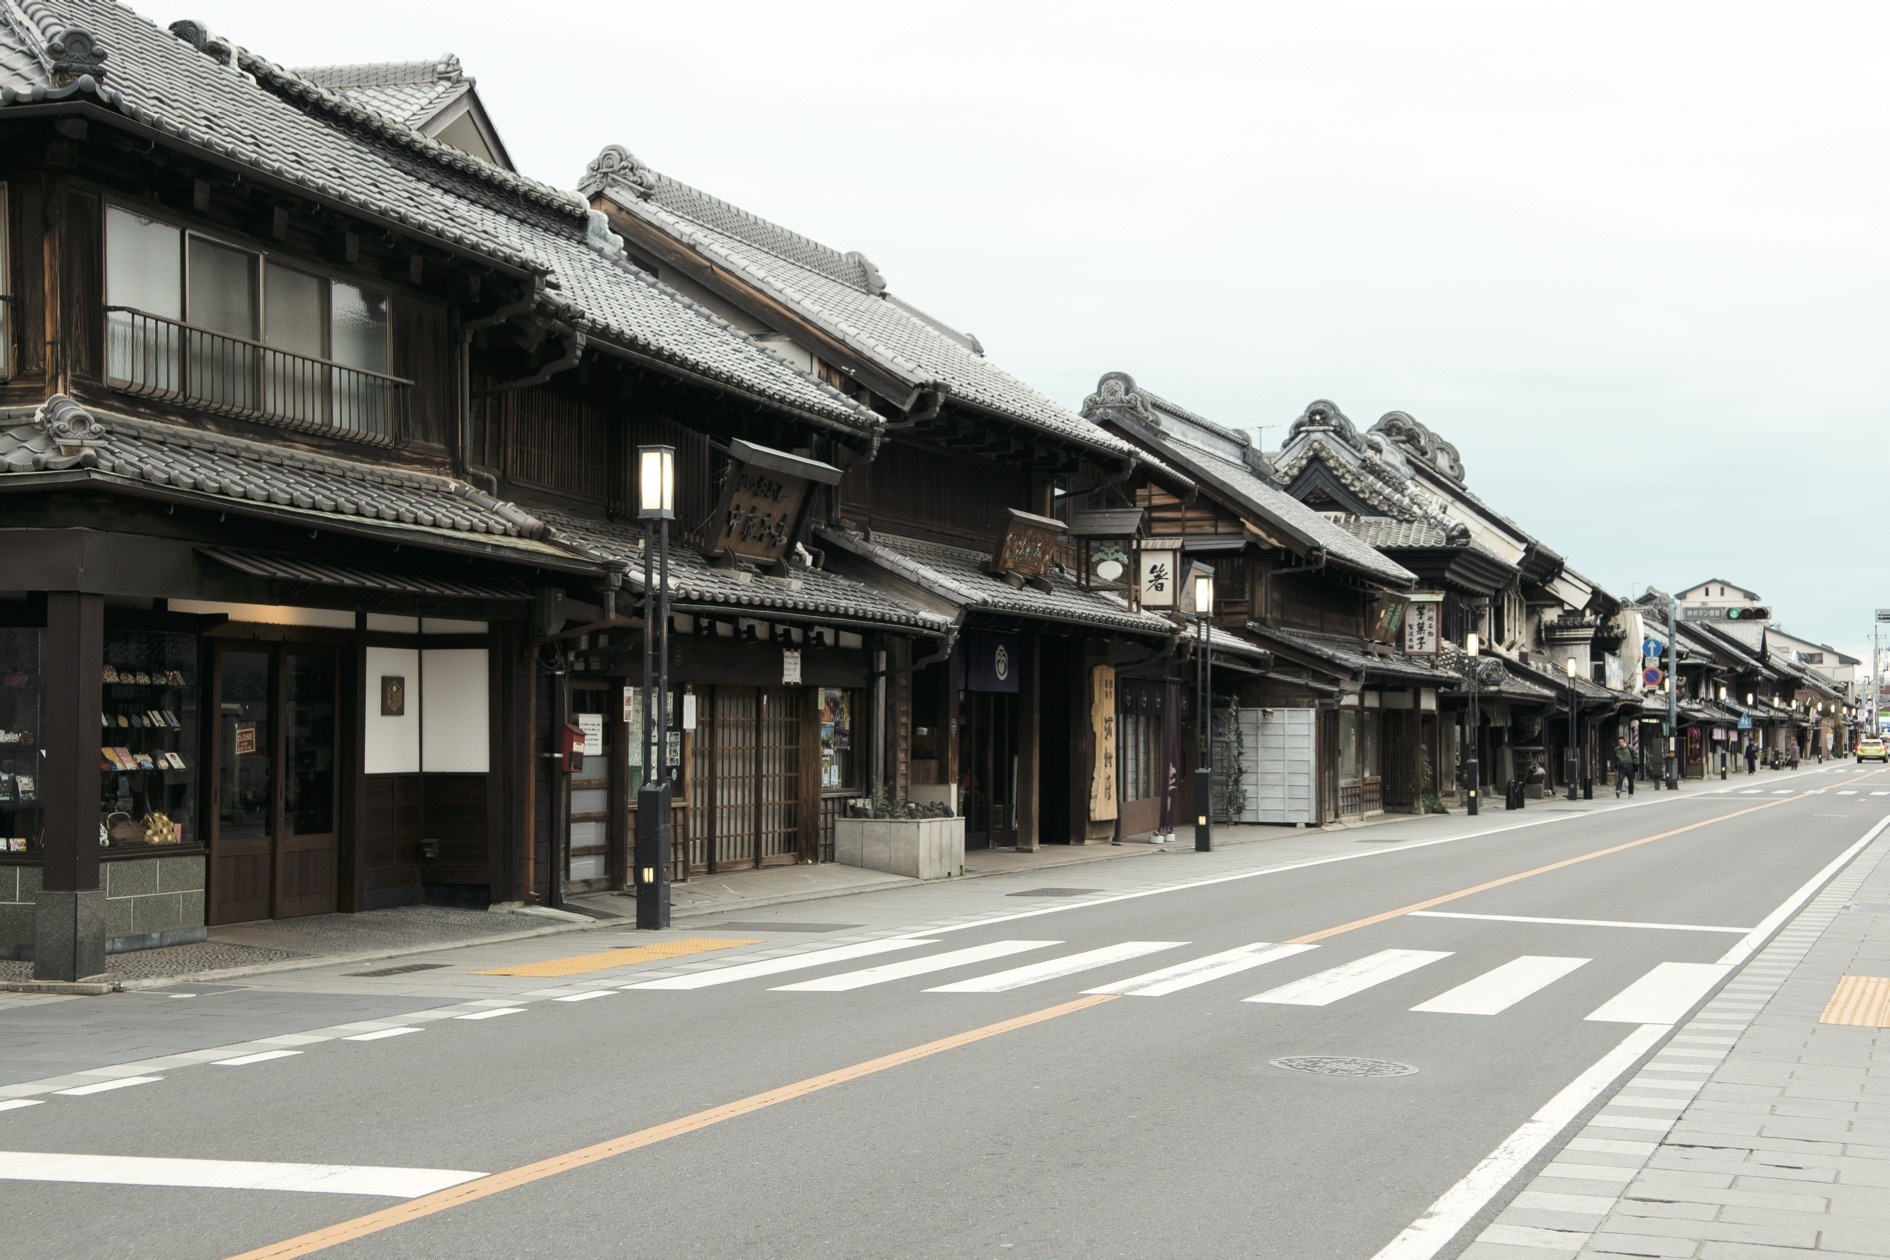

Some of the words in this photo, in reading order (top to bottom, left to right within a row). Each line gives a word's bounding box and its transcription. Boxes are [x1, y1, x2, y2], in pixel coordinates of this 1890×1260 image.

[1146, 563, 1169, 592] 箸
[1415, 604, 1427, 650] 芋菓子
[118, 704, 145, 714] STORE
[237, 733, 254, 742] CLOSE
